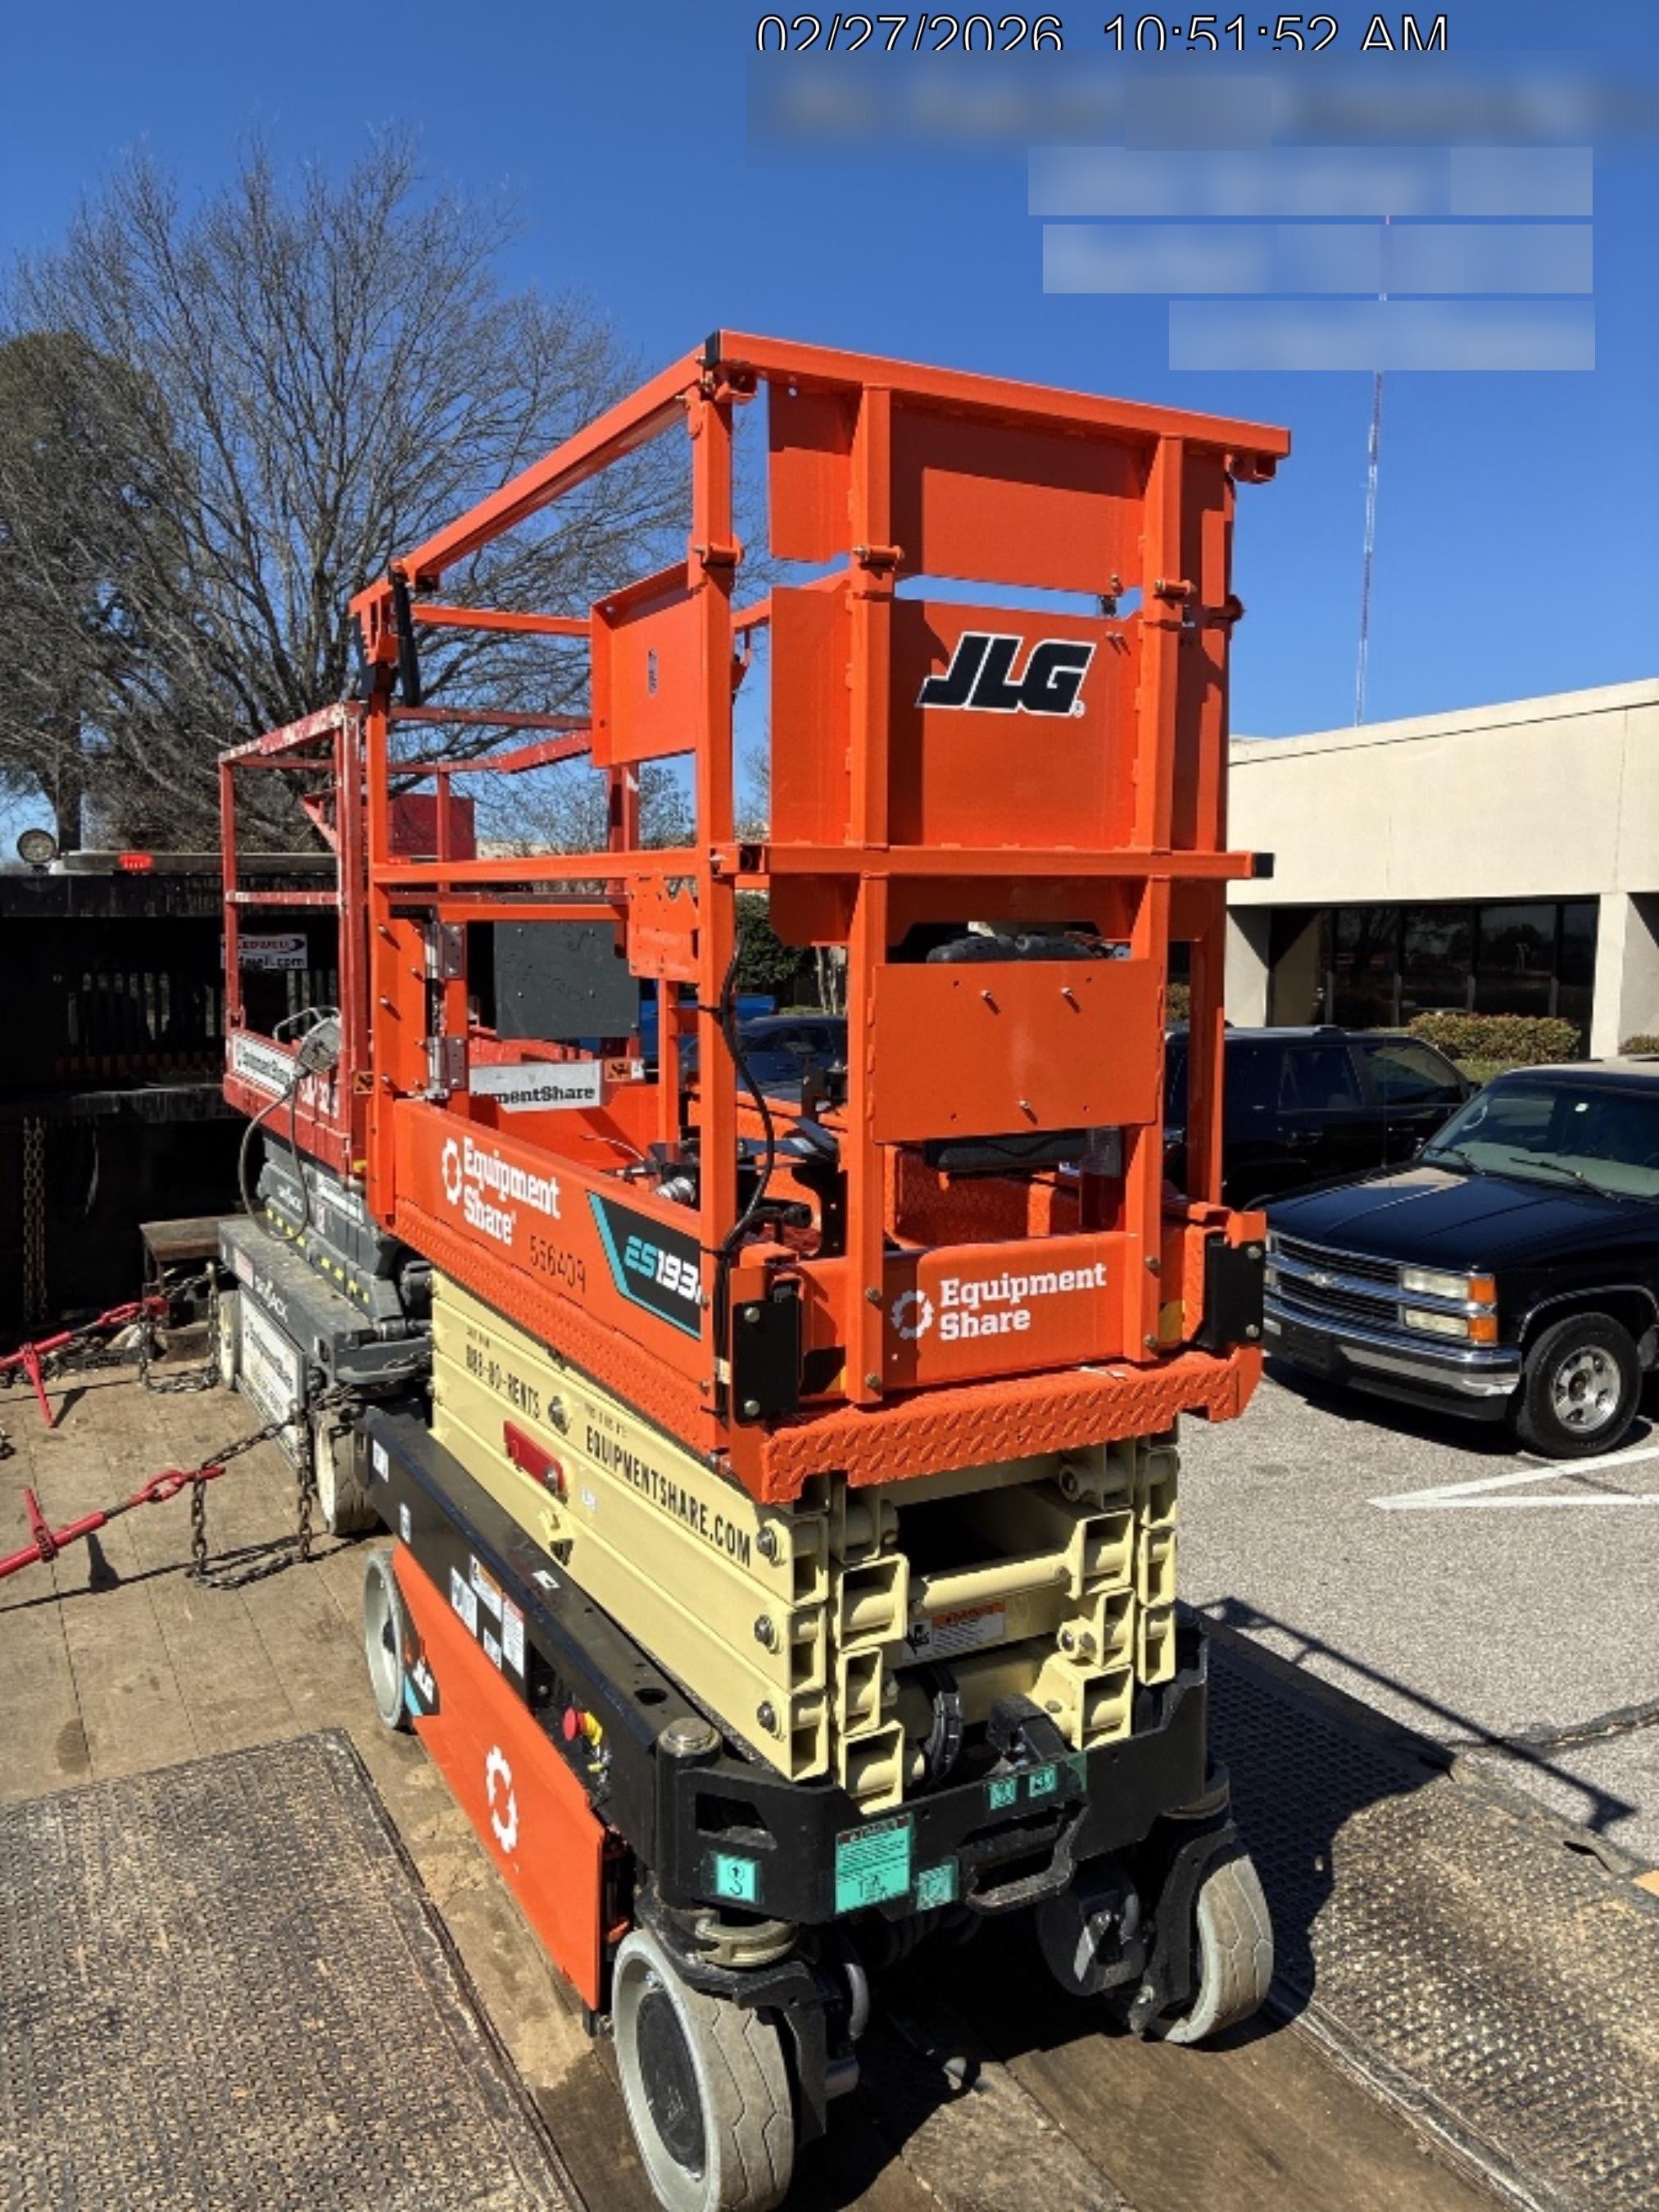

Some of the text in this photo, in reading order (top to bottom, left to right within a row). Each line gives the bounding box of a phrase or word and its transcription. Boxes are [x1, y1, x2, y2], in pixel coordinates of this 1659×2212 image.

[914, 631, 1096, 717] JLG
[464, 1136, 561, 1220] Equipment
[464, 1185, 513, 1246] Share
[940, 1262, 1107, 1309] Equipment
[940, 1309, 1031, 1341] Share
[587, 1425, 751, 1568] EQUIPMENTSHARE.COM
